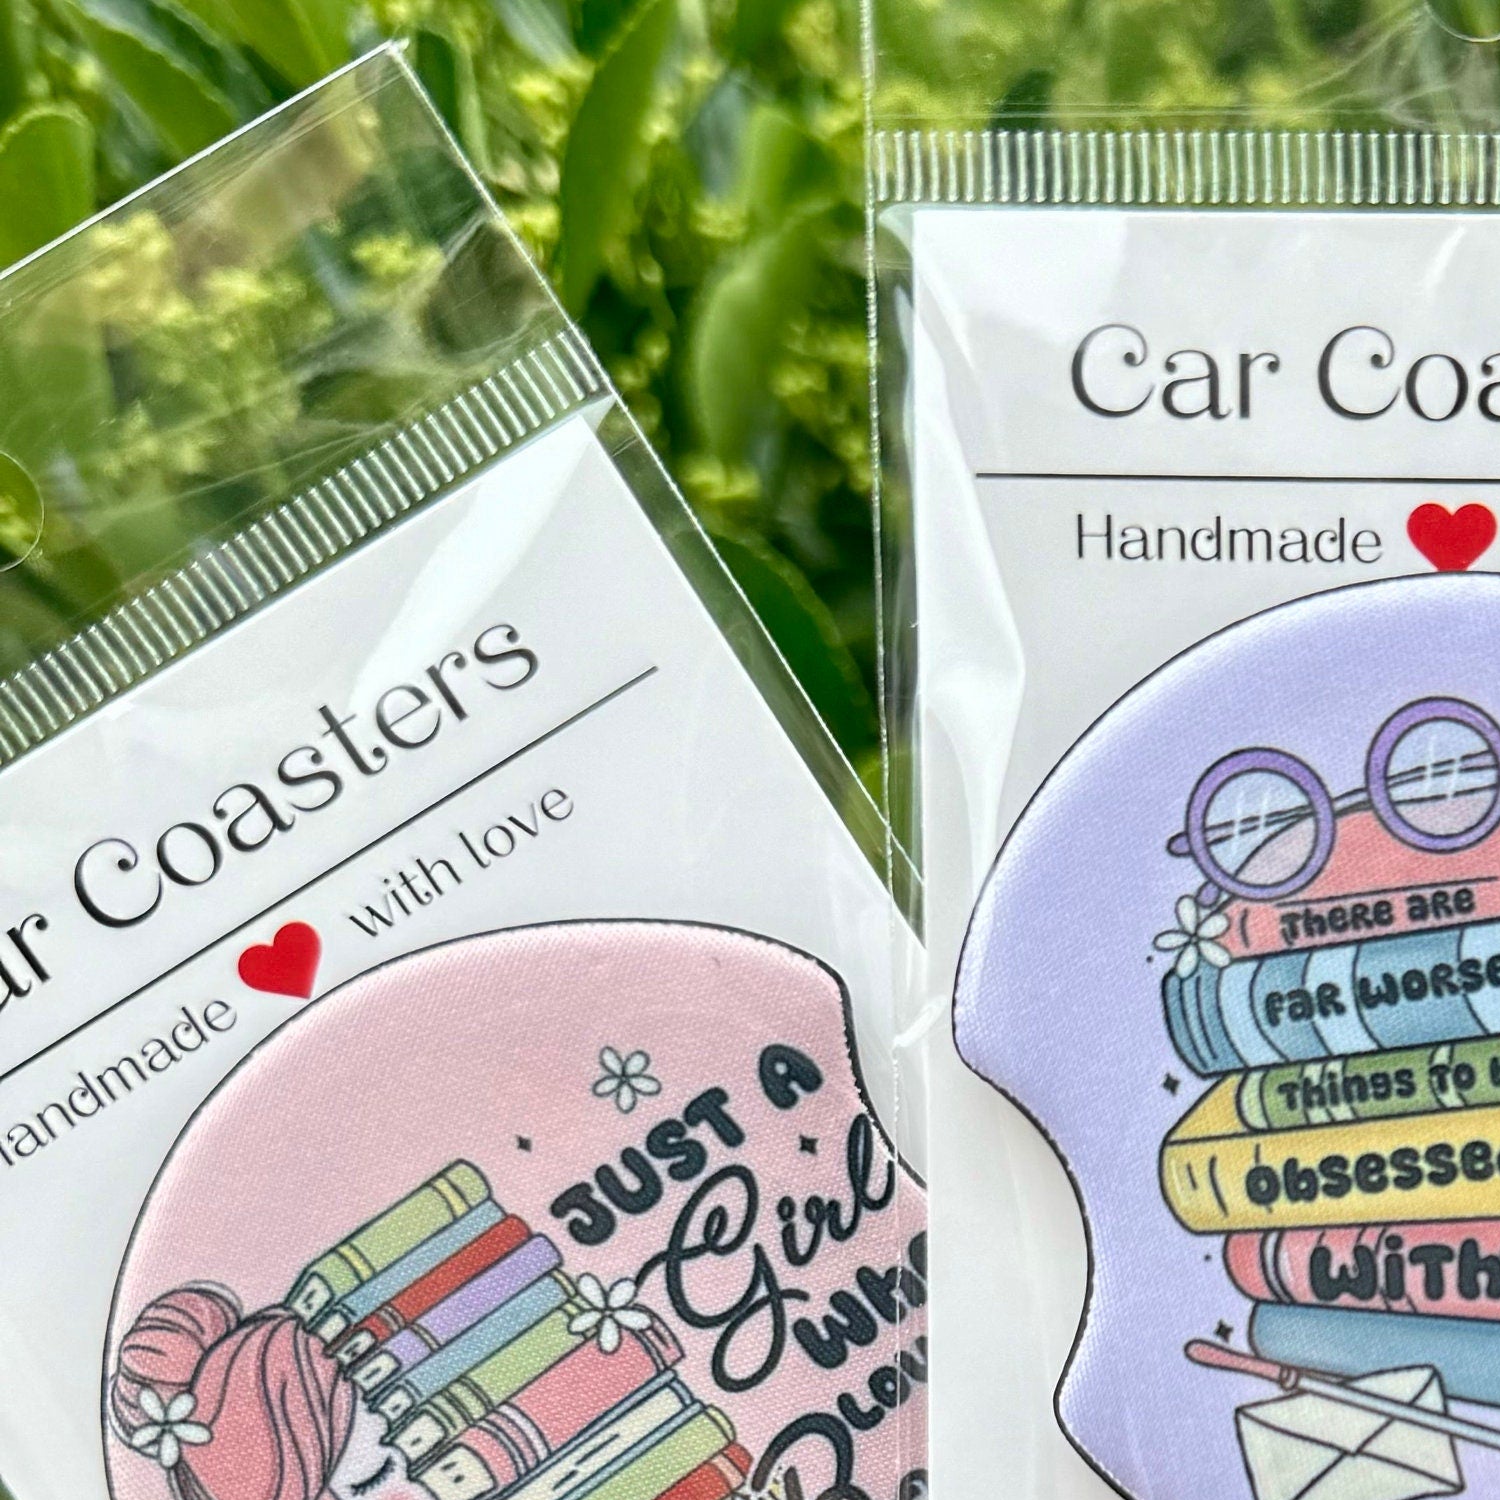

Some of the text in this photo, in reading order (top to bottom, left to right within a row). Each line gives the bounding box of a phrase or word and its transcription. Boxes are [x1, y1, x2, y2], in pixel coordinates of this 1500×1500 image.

[1070, 322, 1281, 424] Car
[1075, 513, 1383, 566] Handmade
[73, 622, 540, 930] Coasters
[0, 783, 576, 1167] andmade with love
[551, 1044, 822, 1247] JUST A
[634, 1112, 896, 1393] Girl
